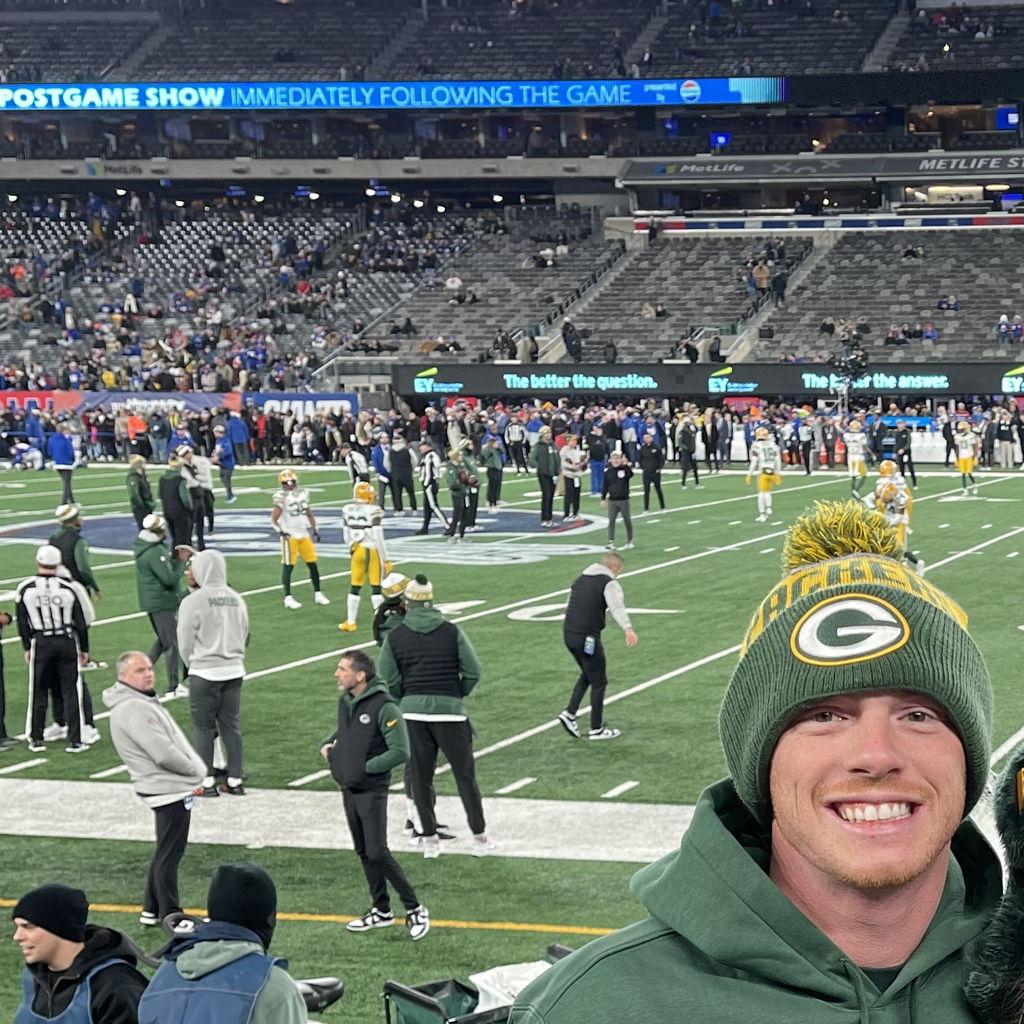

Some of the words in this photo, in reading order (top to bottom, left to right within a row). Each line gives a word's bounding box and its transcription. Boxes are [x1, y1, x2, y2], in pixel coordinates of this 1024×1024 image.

[0, 87, 139, 108] POSTGAME
[146, 87, 225, 108] SHOW
[231, 86, 379, 106] IMMEDIATELY
[381, 86, 514, 105] FOLLOWING
[519, 85, 560, 104] THE
[567, 83, 631, 104] GAME
[680, 163, 745, 173] MetLife
[919, 157, 1002, 170] METLIFE
[413, 377, 434, 393] EY
[503, 374, 529, 389] The
[530, 374, 572, 389] better
[572, 374, 596, 389] the
[597, 374, 658, 391] question.
[802, 373, 829, 389] The
[873, 373, 896, 389] the
[898, 375, 949, 389] answer.
[796, 598, 902, 660] G
